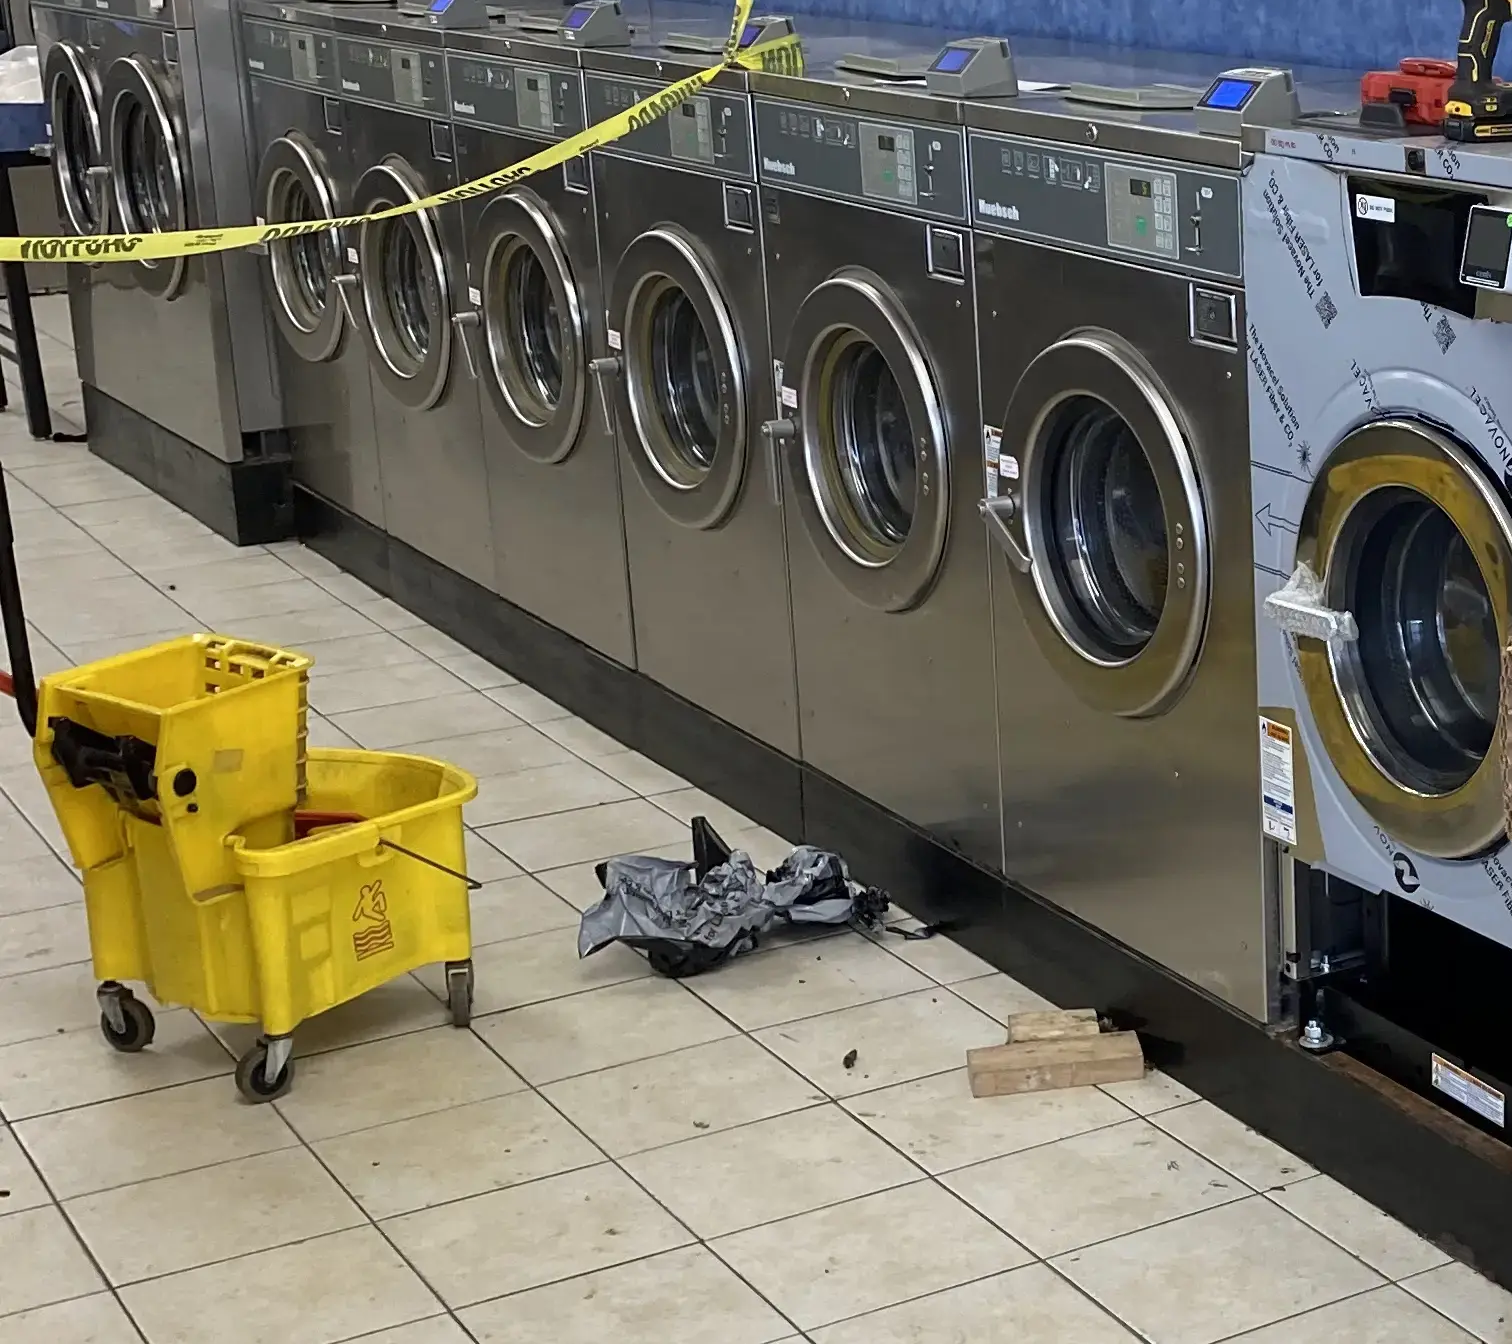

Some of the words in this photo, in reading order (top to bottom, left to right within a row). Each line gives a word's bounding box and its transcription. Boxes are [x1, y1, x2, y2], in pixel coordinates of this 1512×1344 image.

[763, 157, 796, 176] Huebsch
[978, 199, 1020, 221] Huebsch
[1262, 189, 1284, 235] Solution
[1282, 205, 1297, 235] Fiber
[1281, 233, 1306, 275] Novacel
[1293, 232, 1316, 271] LASER
[1303, 278, 1316, 299] The
[1249, 324, 1259, 346] The
[1258, 343, 1280, 387] Novacel
[1277, 385, 1299, 430] Solution
[1250, 351, 1267, 387] LASER
[1266, 385, 1280, 415] Fiber
[1469, 385, 1511, 461] NOVACEL
